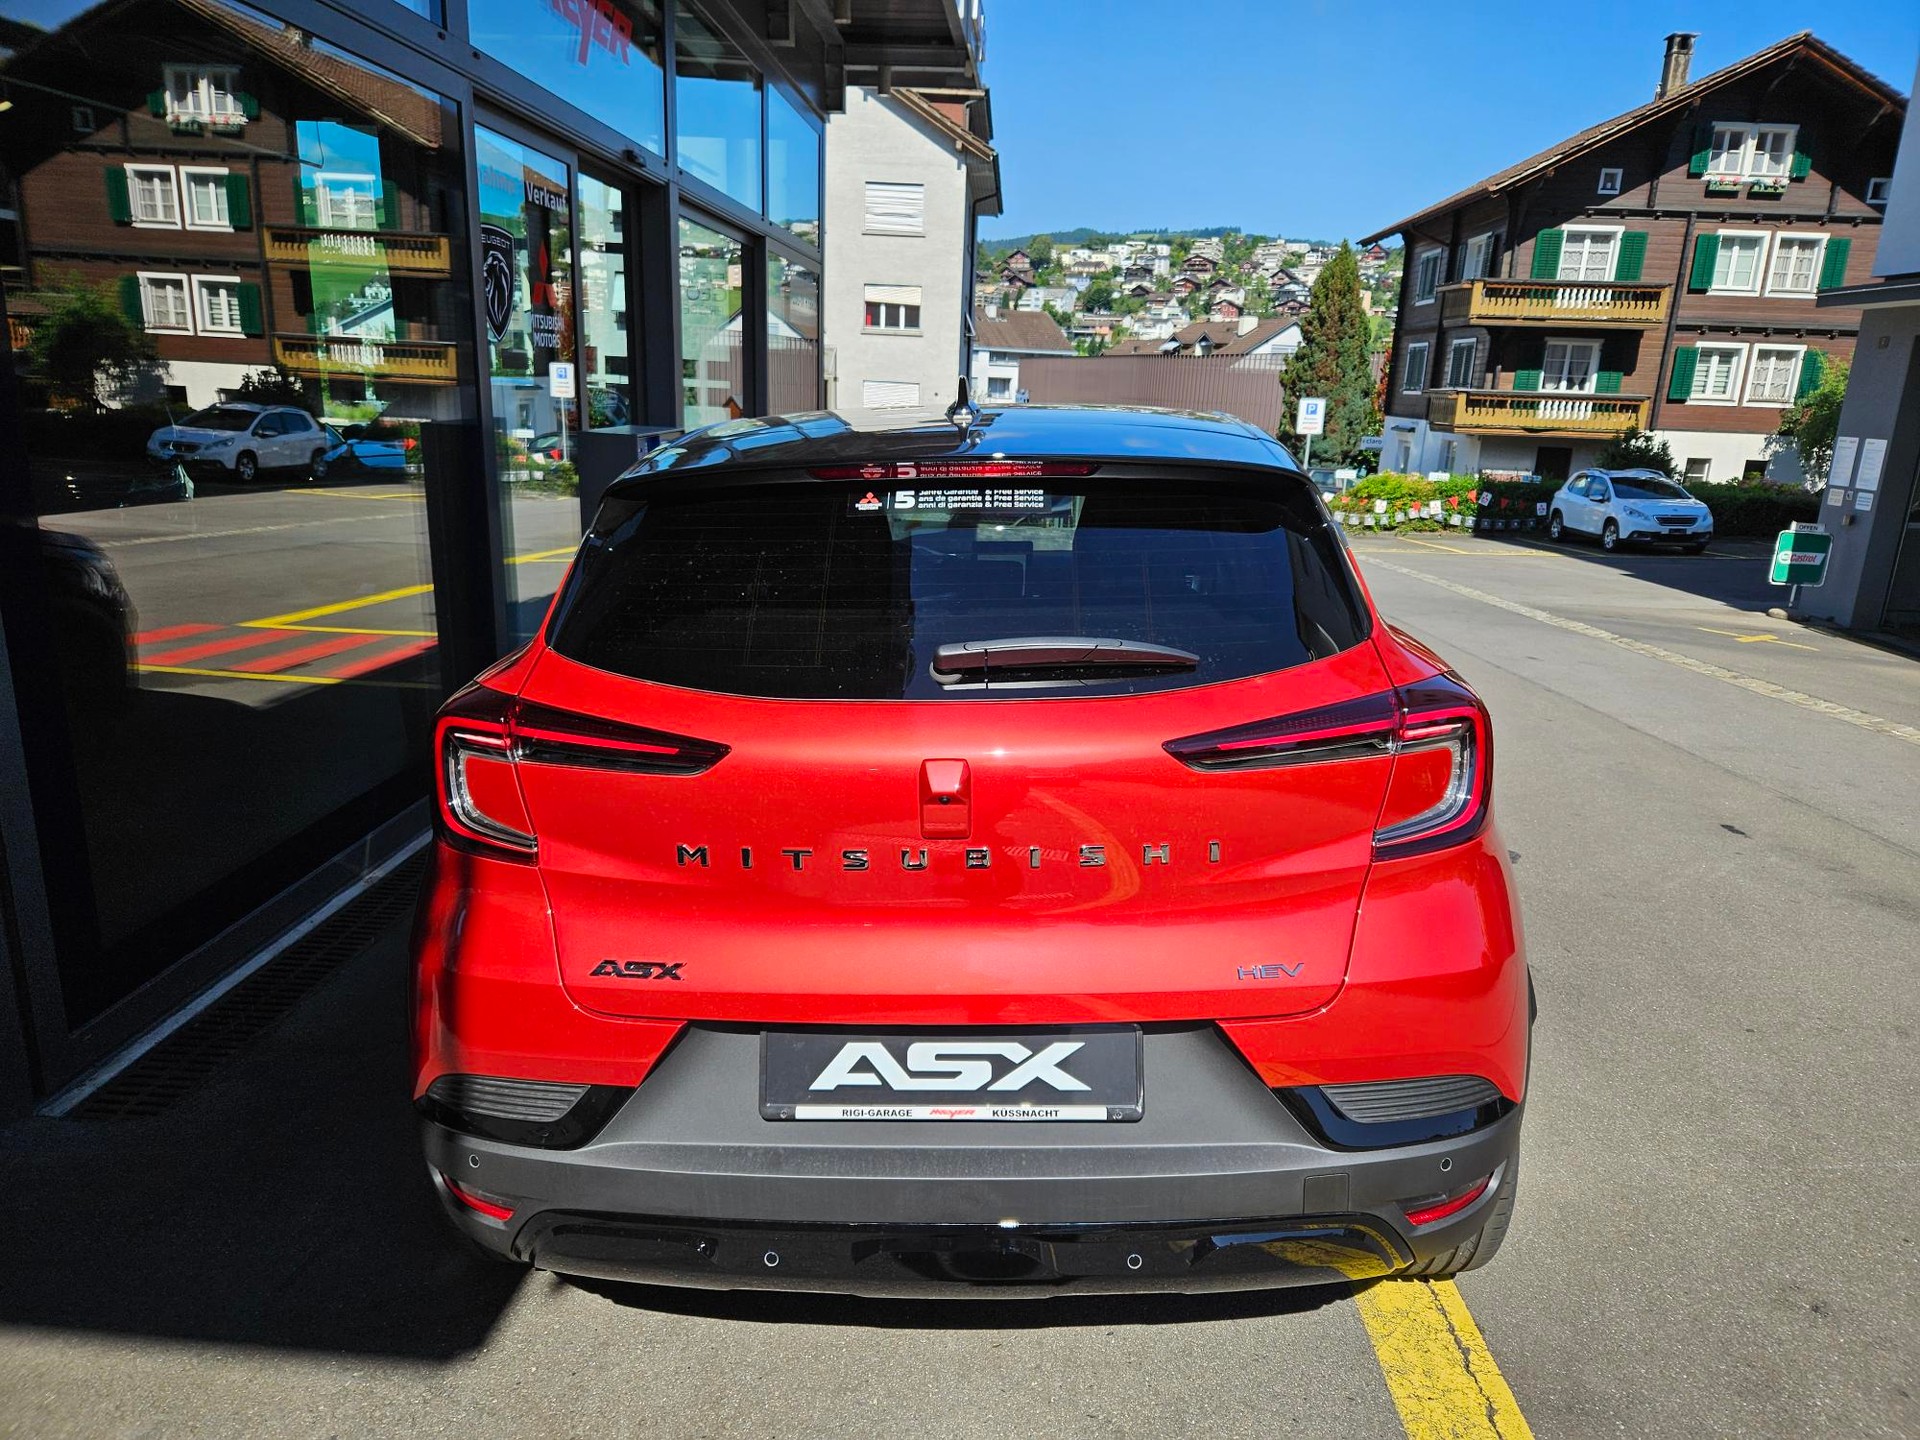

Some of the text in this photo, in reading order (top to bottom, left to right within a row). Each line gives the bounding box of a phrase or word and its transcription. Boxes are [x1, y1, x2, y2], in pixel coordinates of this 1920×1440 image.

[524, 180, 568, 214] Verkauf
[480, 233, 511, 250] EUGEOT
[533, 332, 562, 349] MOTORS
[894, 490, 915, 509] 5
[1790, 554, 1817, 563] Castrol
[676, 839, 1221, 870] MITSUBISHI
[589, 959, 687, 981] ASX
[1237, 962, 1304, 980] HEV
[808, 1041, 1092, 1091] ASX
[841, 1108, 913, 1118] RIGI-GARAGE
[992, 1107, 1060, 1118] KÜSSNACHT
